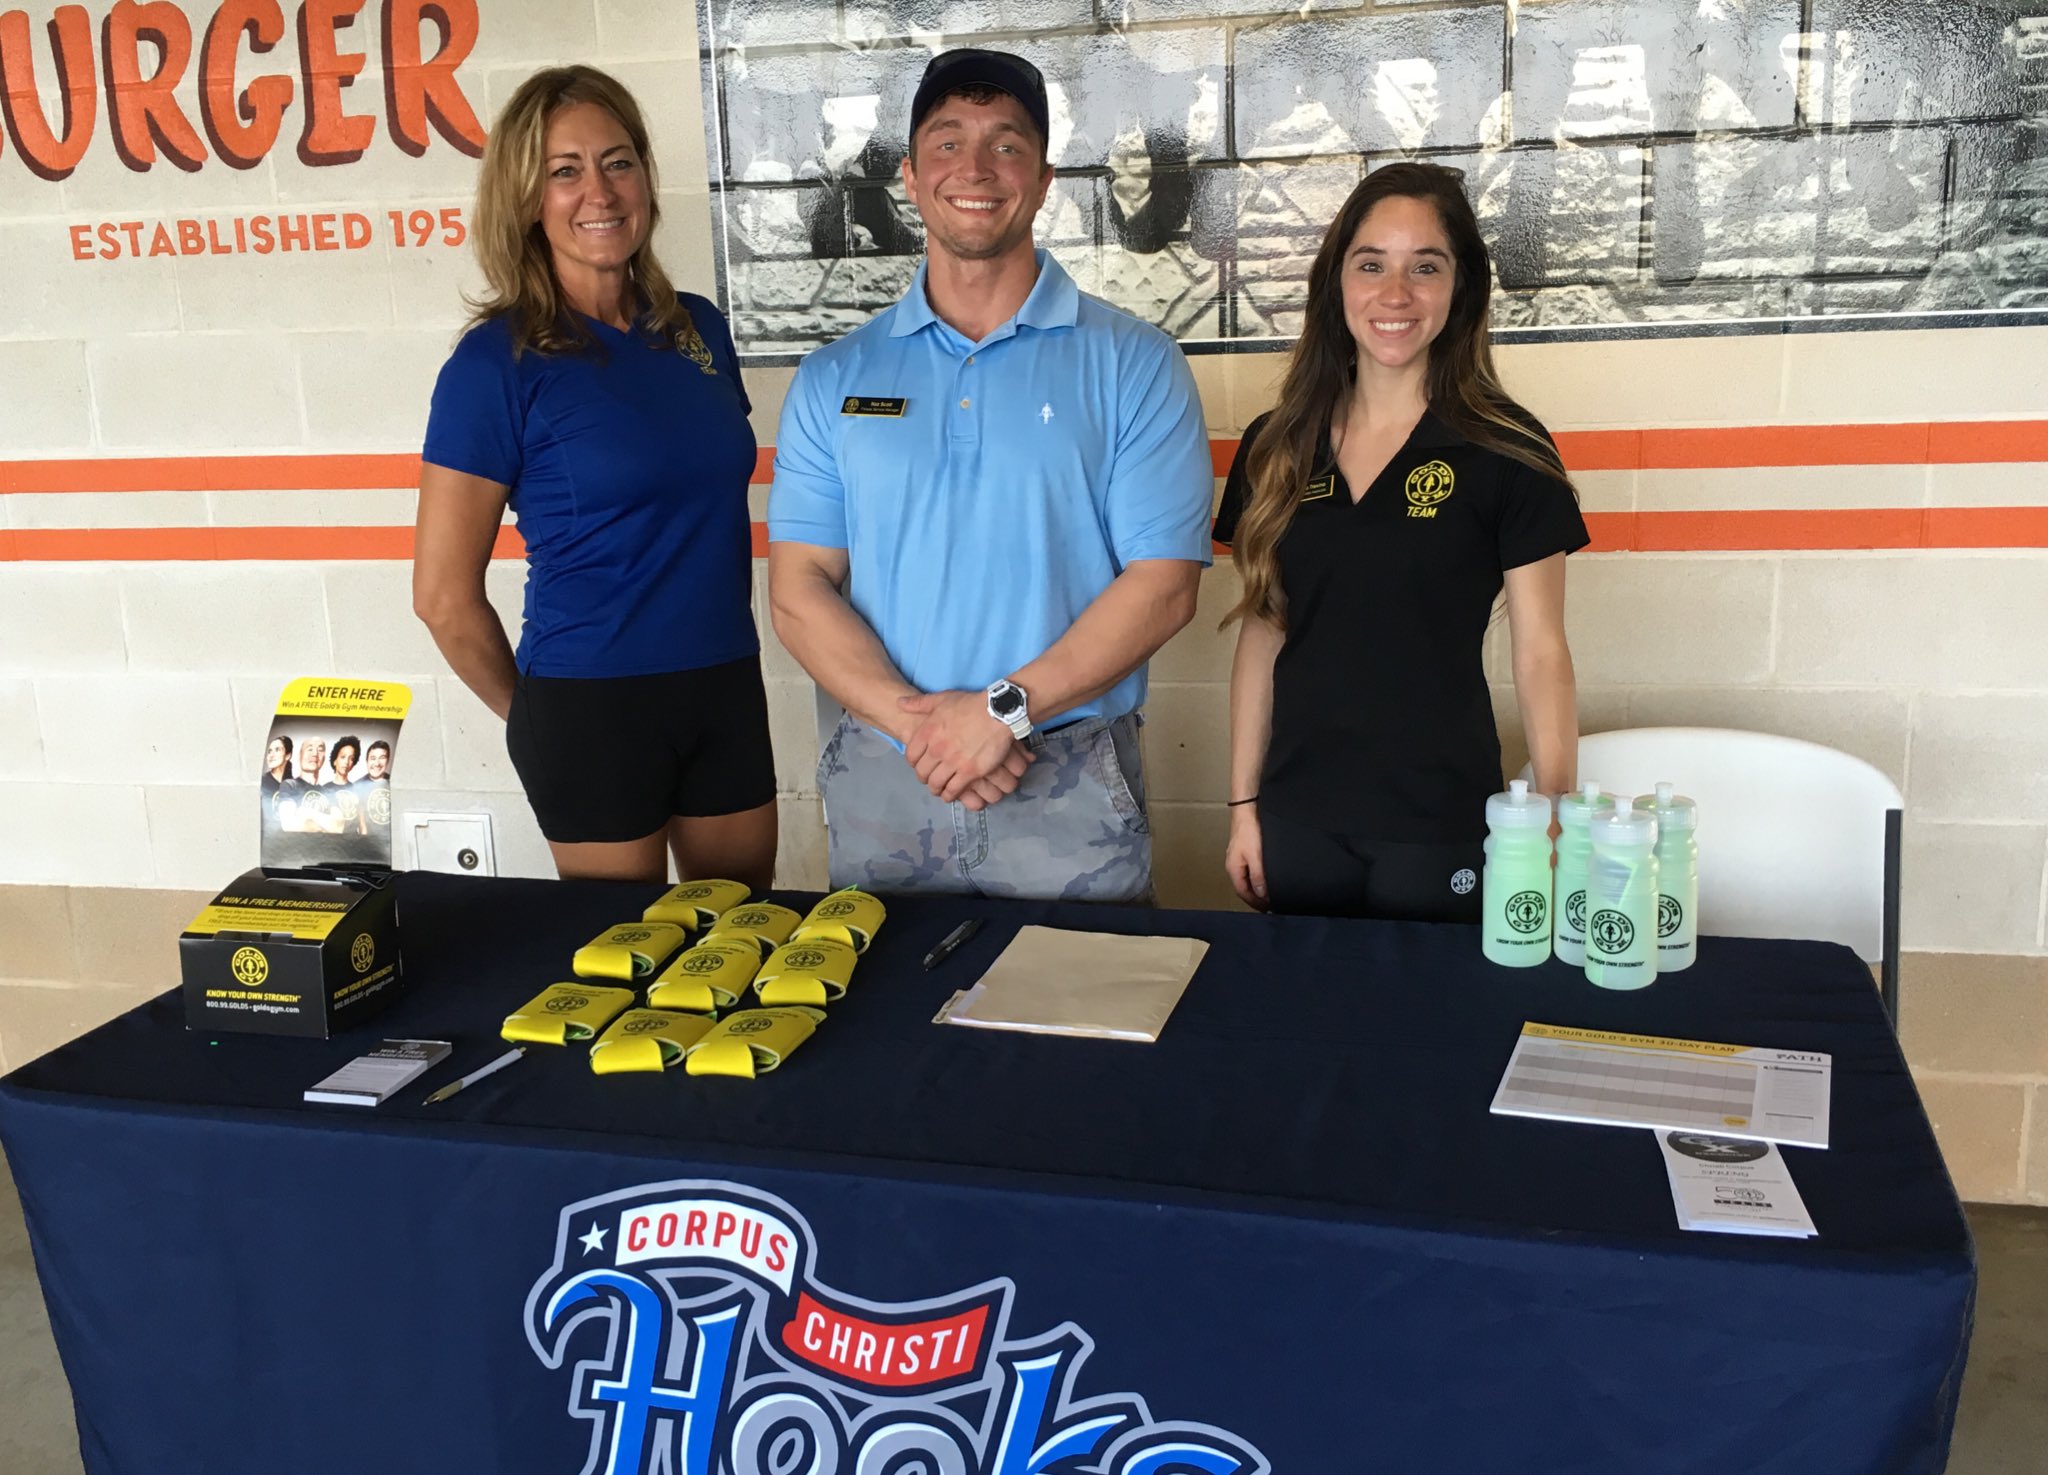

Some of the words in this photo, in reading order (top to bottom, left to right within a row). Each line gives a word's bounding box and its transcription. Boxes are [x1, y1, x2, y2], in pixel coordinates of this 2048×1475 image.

[0, 0, 488, 182] URGER
[70, 212, 373, 261] ESTABLISHED
[386, 208, 467, 249] 195
[1406, 506, 1437, 518] TEAM
[308, 686, 348, 699] ENTER
[350, 688, 386, 701] HERE
[342, 703, 358, 712] Gym
[359, 704, 403, 714] Membership
[220, 896, 240, 904] WIN
[249, 898, 276, 906] FREE
[277, 899, 348, 910] MEMBERSHIP!
[206, 989, 227, 997] KNOW
[228, 990, 246, 999] YOUR
[247, 992, 263, 1000] OWN
[252, 1004, 300, 1014] goldsgym.com
[1552, 1028, 1582, 1037] YOUR
[1585, 1032, 1627, 1041] GOLD'S
[1704, 1044, 1736, 1052] PLAN
[1776, 1054, 1822, 1062] PATH
[626, 1208, 790, 1273] CORPUS
[802, 1310, 970, 1374] CHRISTI
